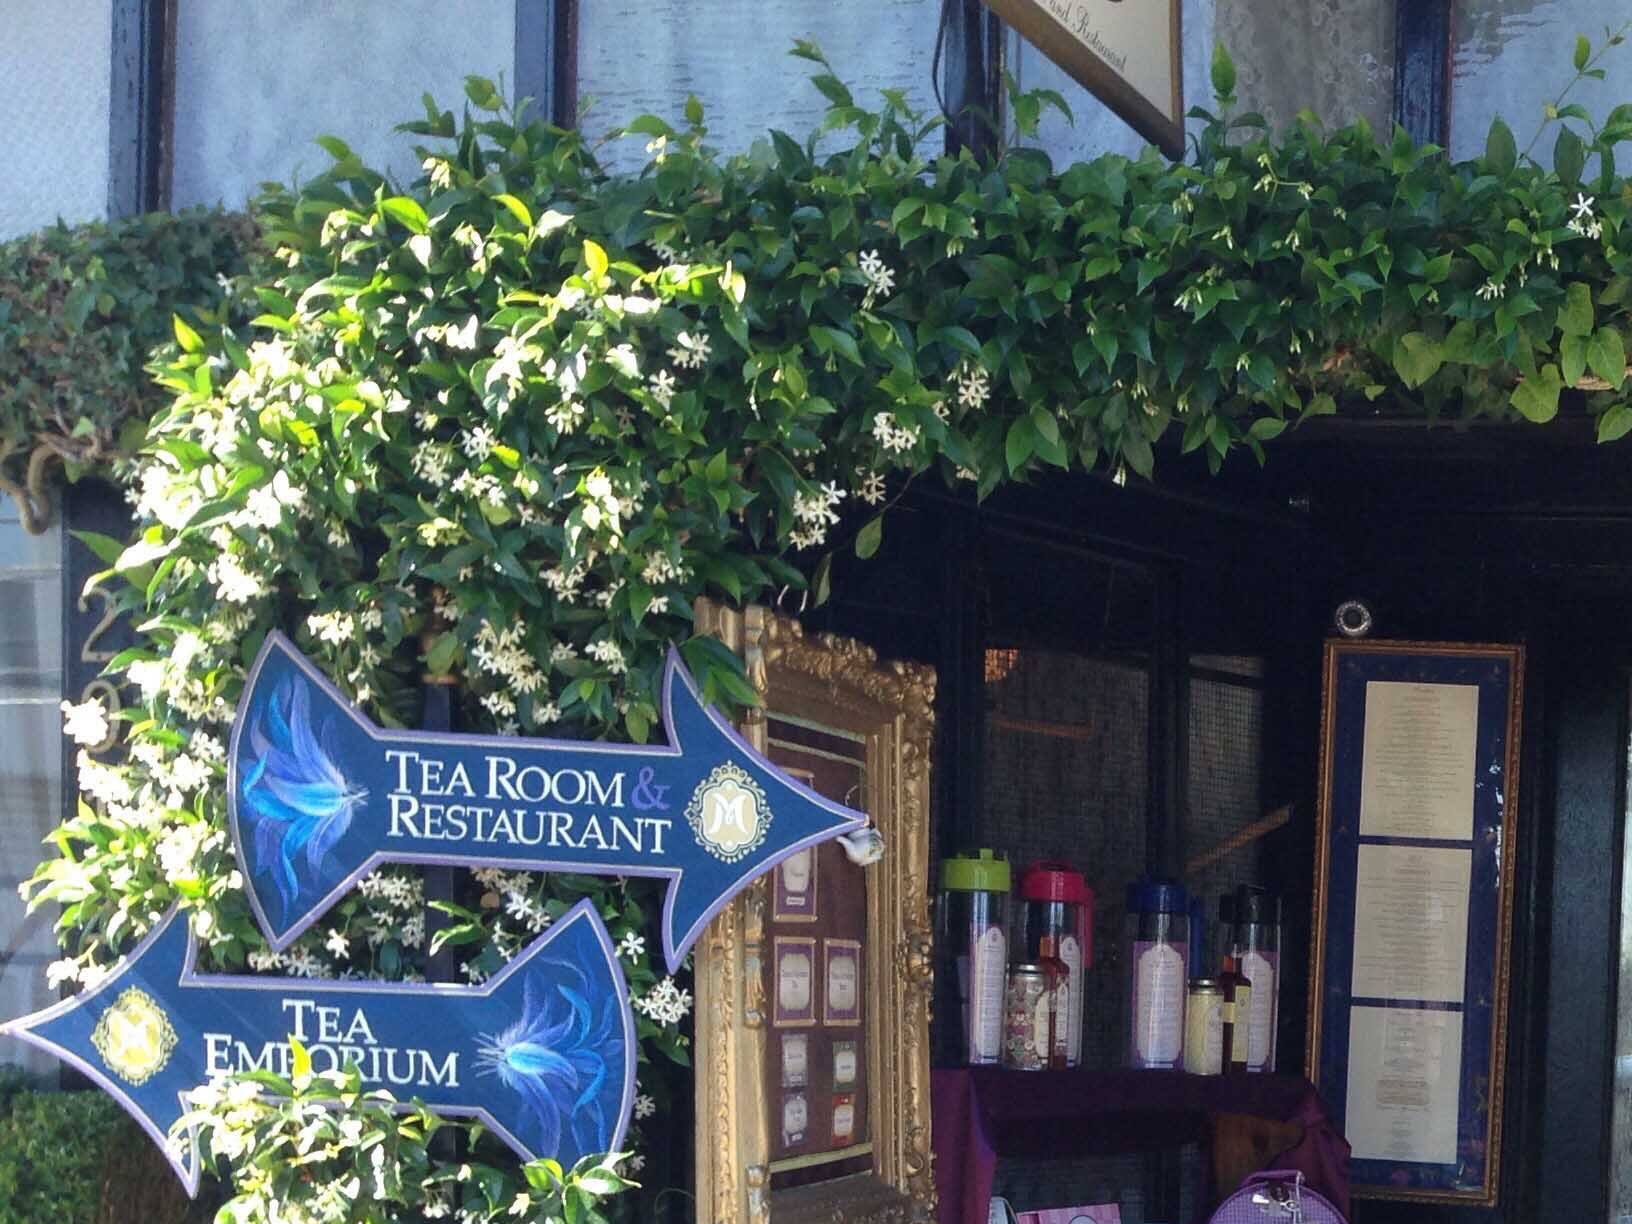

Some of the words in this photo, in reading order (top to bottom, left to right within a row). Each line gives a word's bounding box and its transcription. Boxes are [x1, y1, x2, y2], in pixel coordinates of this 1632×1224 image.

[385, 750, 476, 798] TEA
[484, 756, 626, 808] ROOM
[631, 766, 671, 810] &
[386, 794, 672, 854] RESTAURANT
[282, 998, 377, 1045] TEA
